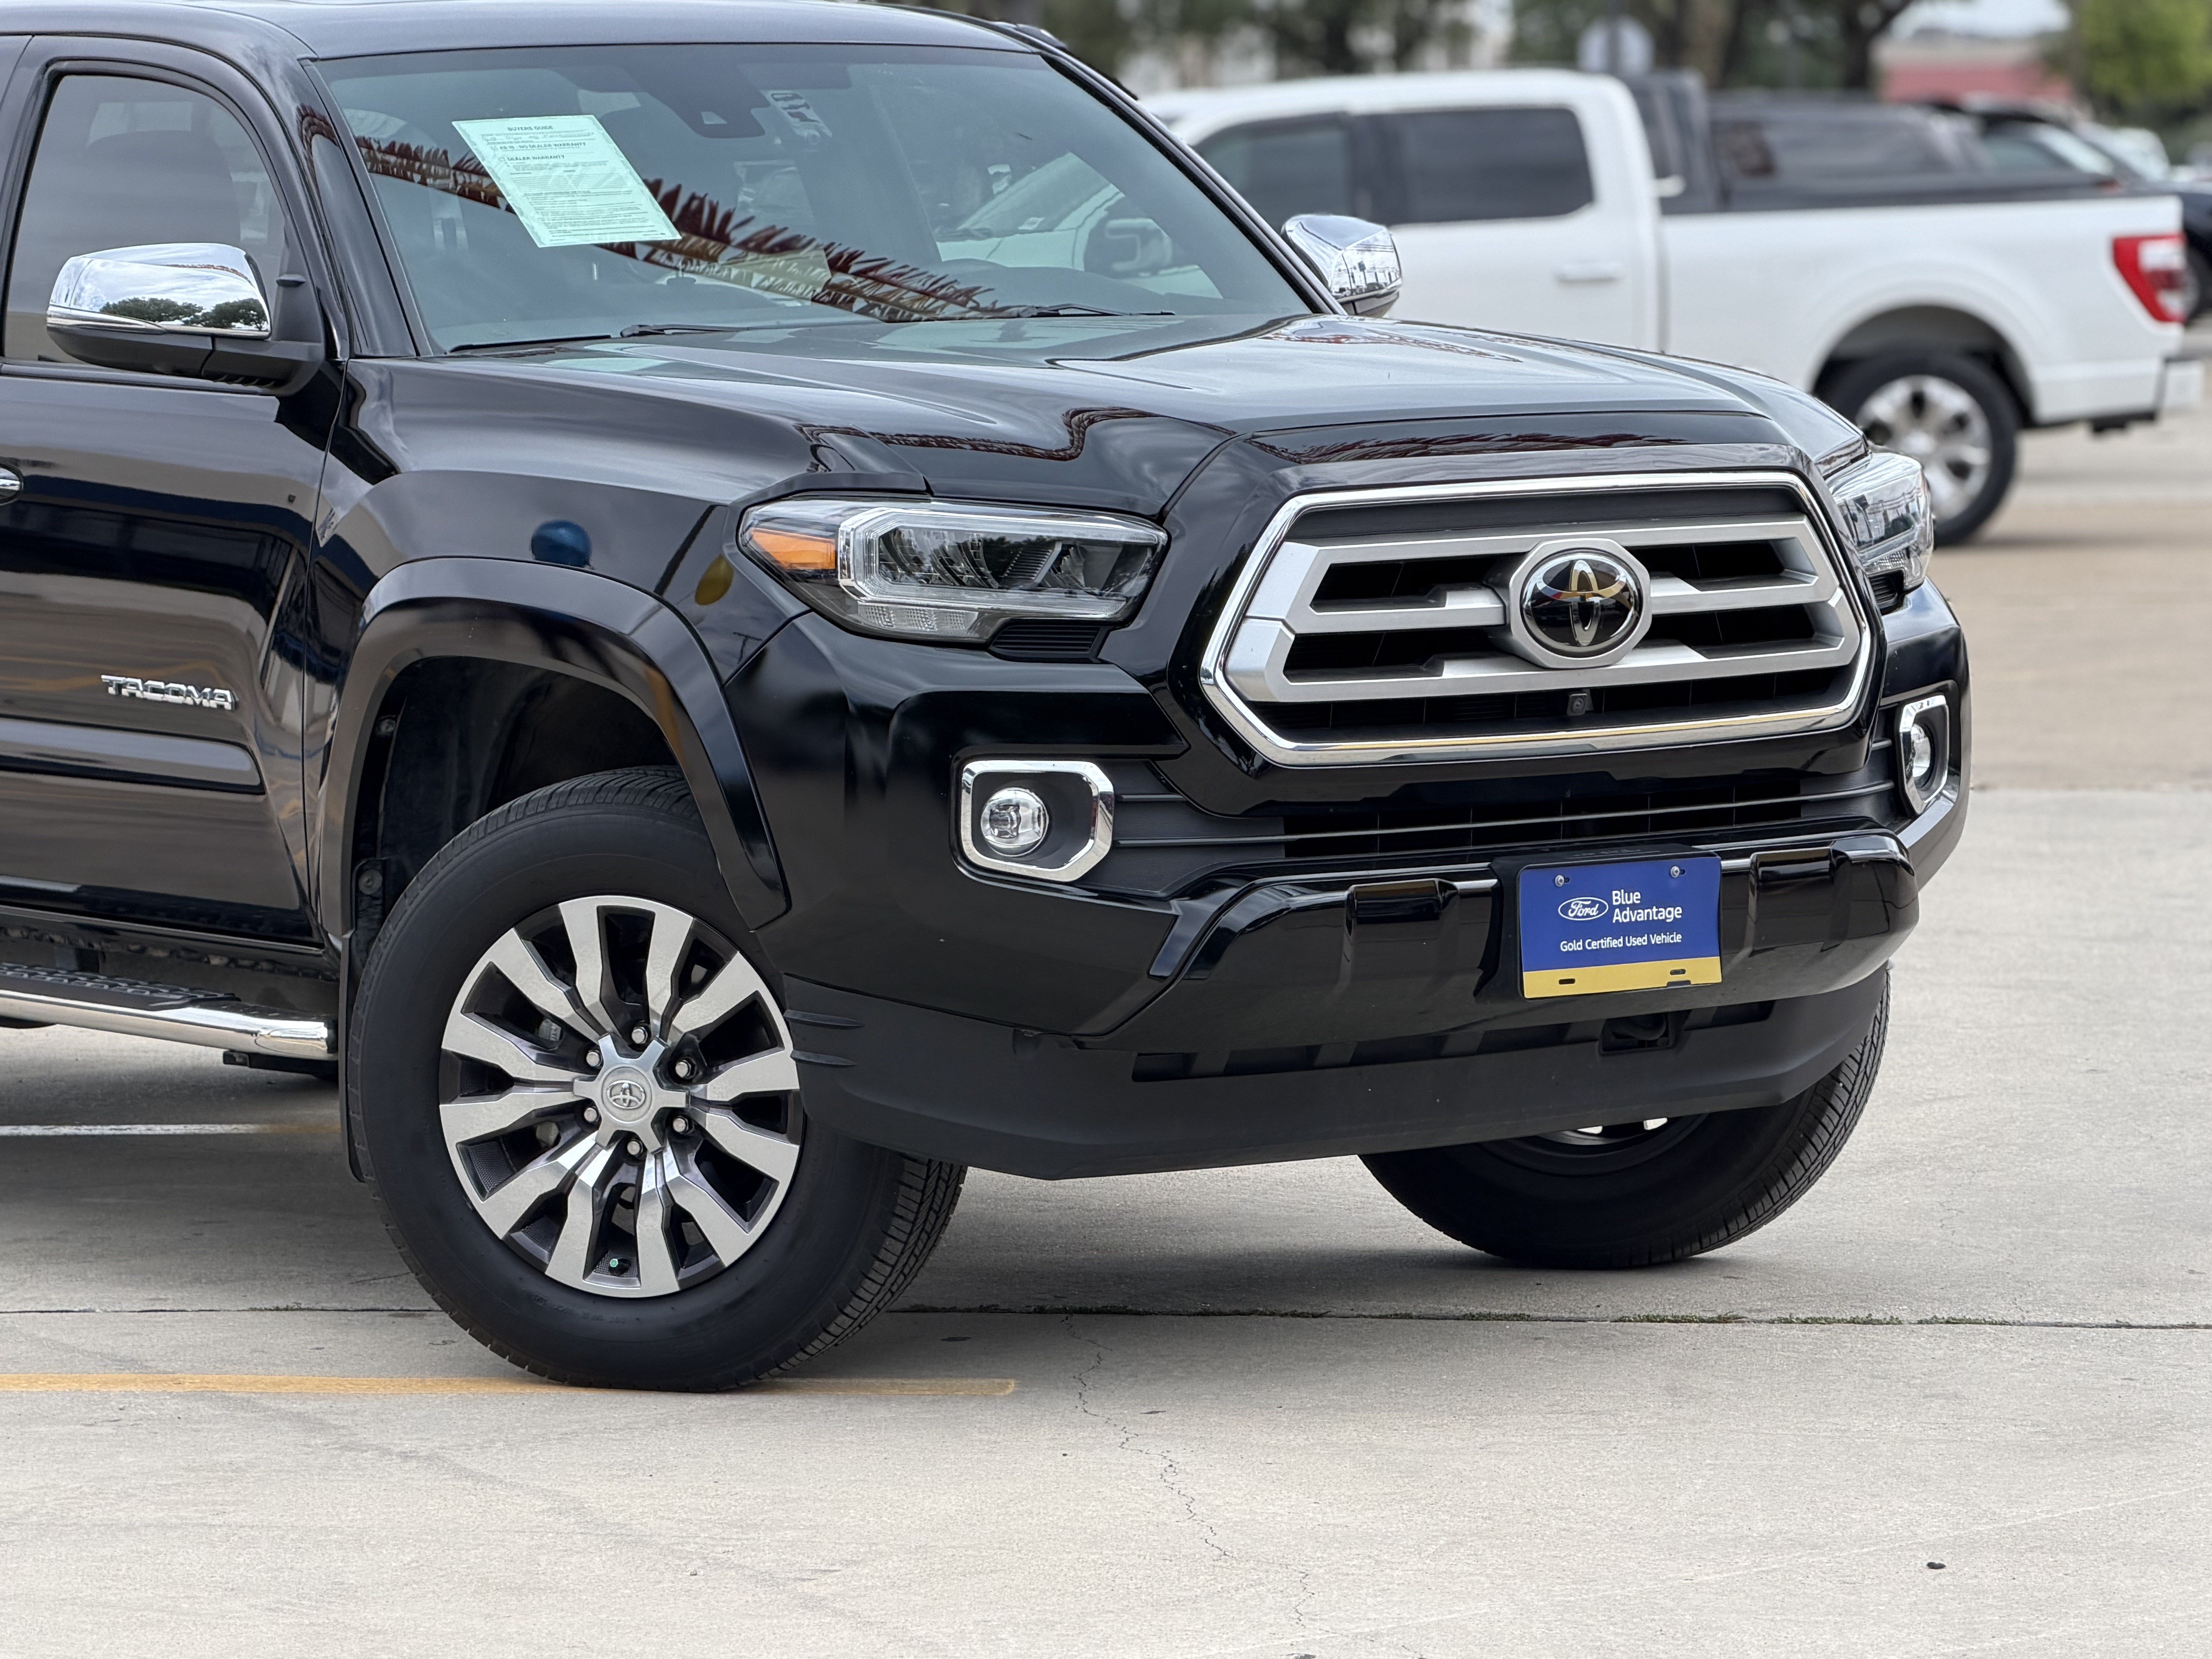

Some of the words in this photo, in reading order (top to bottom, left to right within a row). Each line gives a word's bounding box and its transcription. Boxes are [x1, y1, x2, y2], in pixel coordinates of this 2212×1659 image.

[101, 675, 238, 711] TACOMA
[1612, 889, 1641, 905] Blue
[1568, 901, 1599, 917] Ford
[1612, 906, 1682, 923] Advantage
[1560, 939, 1583, 951] Gold
[1585, 936, 1623, 950] Certified
[1625, 934, 1647, 946] Used
[1650, 932, 1682, 944] Vehicle
